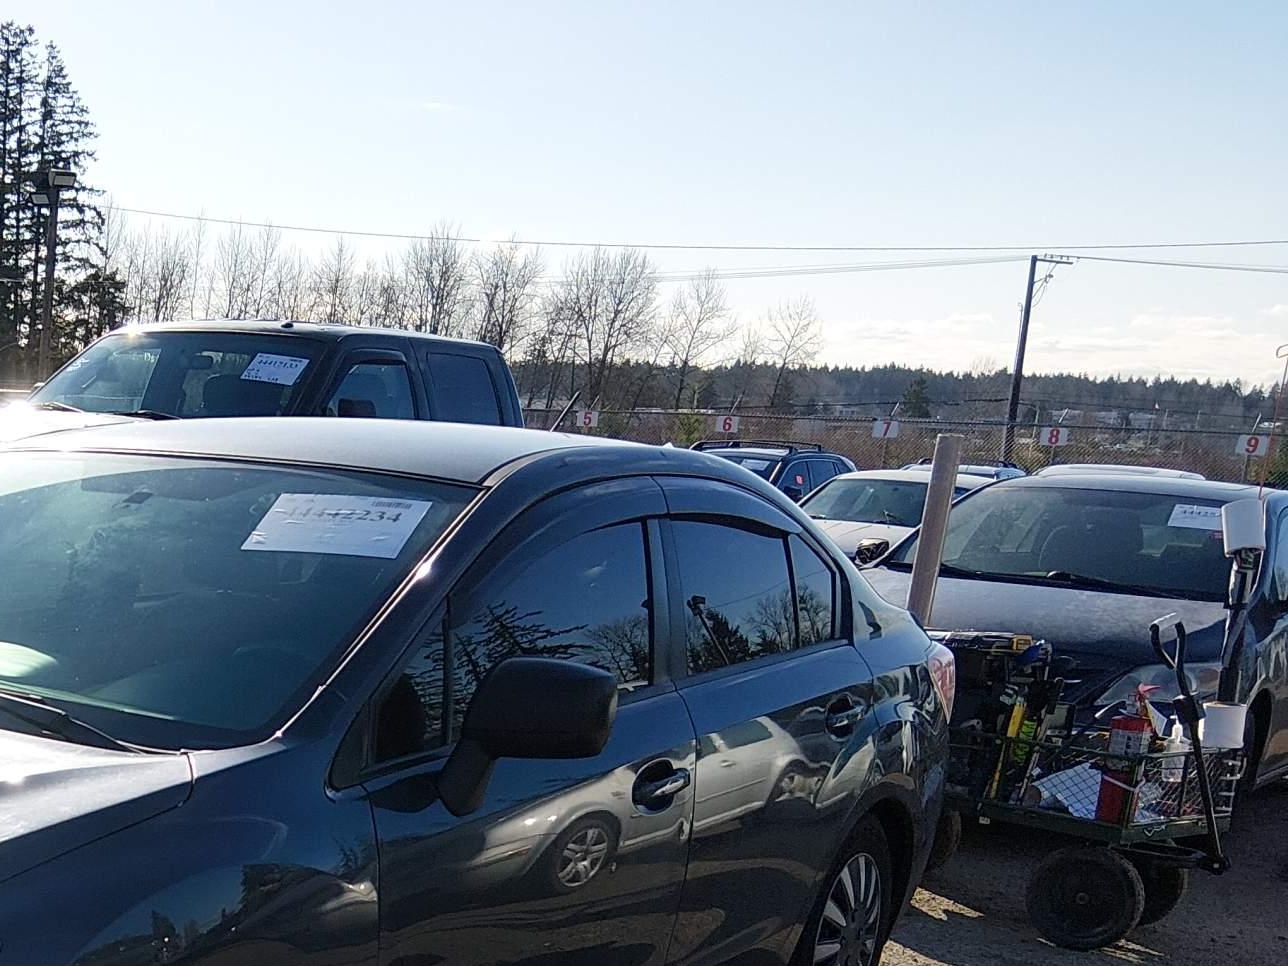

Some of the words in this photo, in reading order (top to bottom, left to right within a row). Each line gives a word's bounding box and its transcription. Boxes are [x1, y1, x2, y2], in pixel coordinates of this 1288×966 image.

[584, 412, 593, 426] 5
[722, 416, 732, 431] 6
[882, 421, 892, 437] 7
[1048, 428, 1060, 445] 8
[1246, 436, 1259, 453] 9
